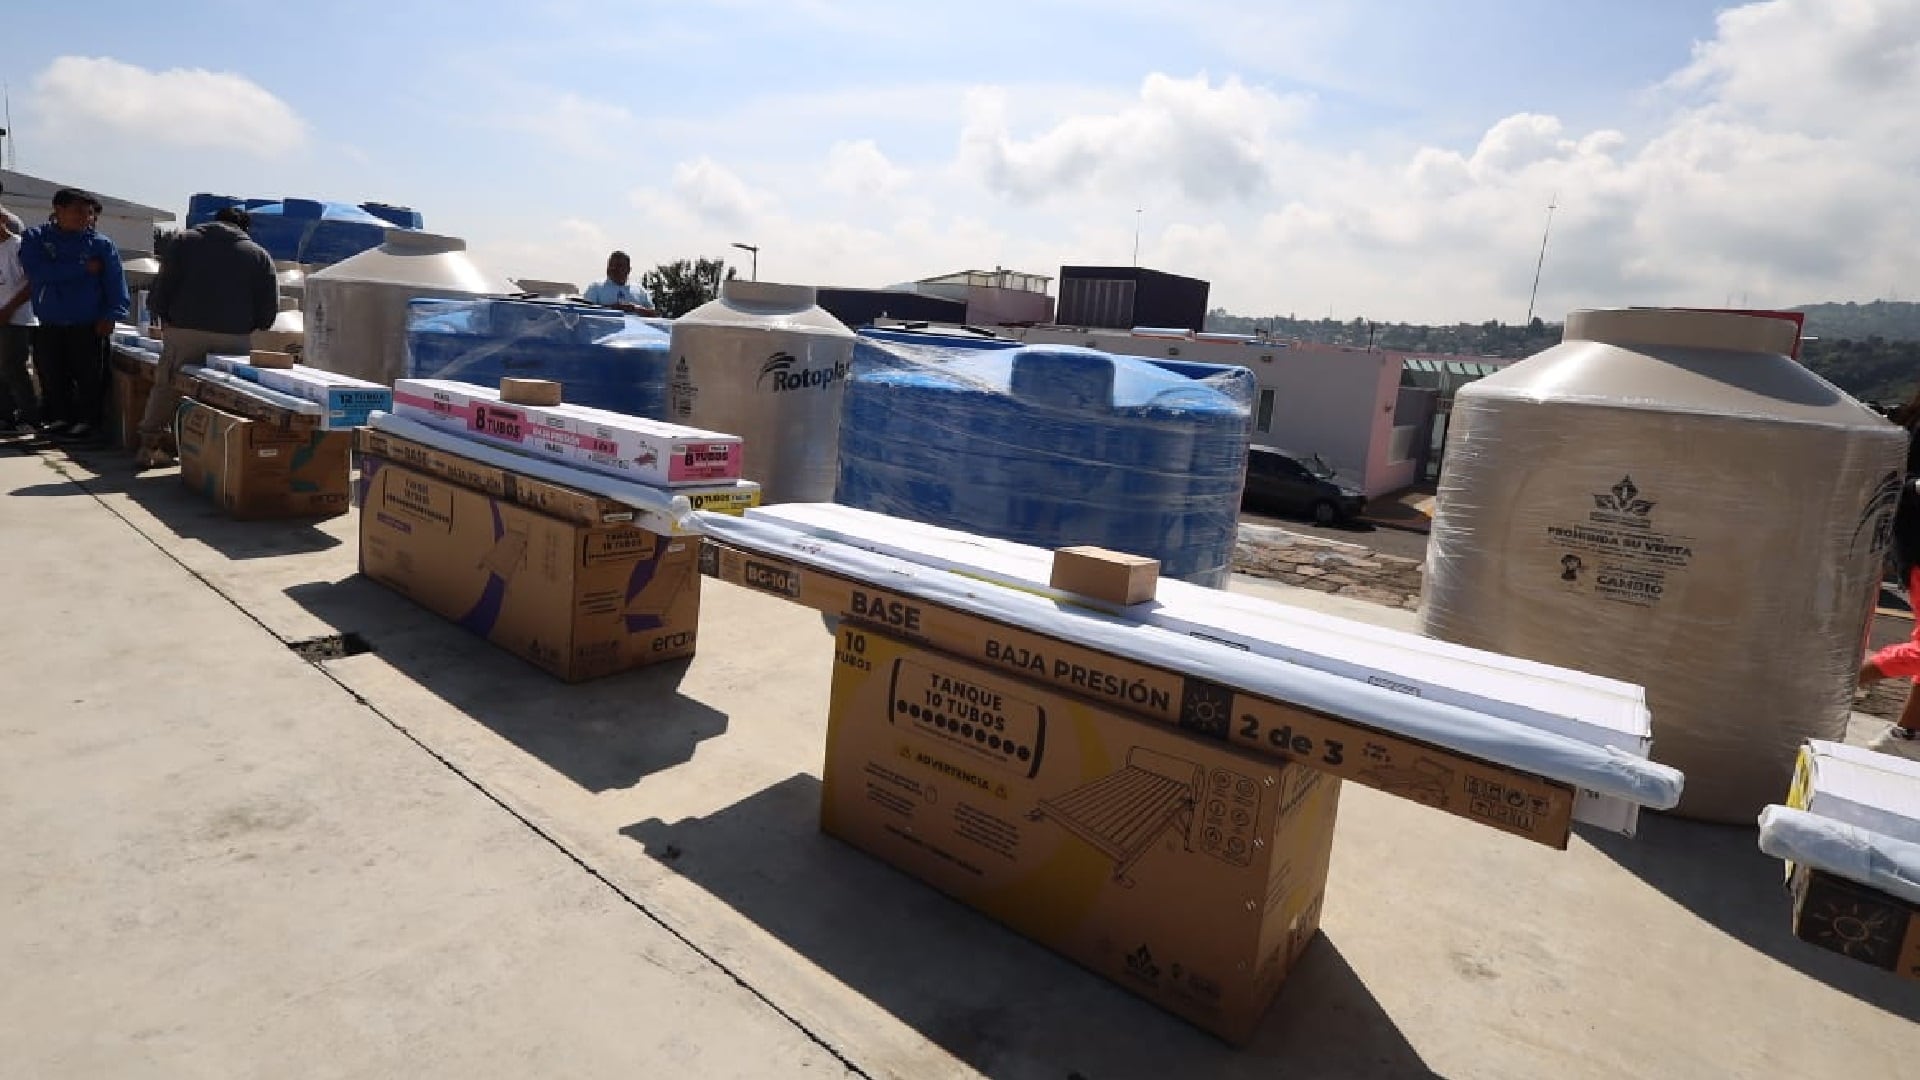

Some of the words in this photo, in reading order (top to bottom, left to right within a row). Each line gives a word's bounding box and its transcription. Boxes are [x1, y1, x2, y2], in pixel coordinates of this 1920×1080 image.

[476, 406, 486, 430] 8
[487, 417, 521, 439] TUBOS
[684, 454, 694, 466] 8
[695, 451, 729, 461] TUBOS
[689, 496, 703, 509] 10
[852, 591, 921, 632] BASE
[836, 651, 873, 671] TUBOS
[845, 631, 866, 653] 10
[931, 673, 1003, 711] TANQUE
[985, 639, 1046, 676] BAJA
[1053, 659, 1171, 713] PRESIÓN
[925, 690, 943, 708] 10
[949, 699, 1005, 732] TUBOS
[1239, 713, 1260, 740] 2
[1267, 723, 1314, 757] de
[1322, 739, 1345, 766] 3
[915, 752, 990, 790] ADVERTENCIA
